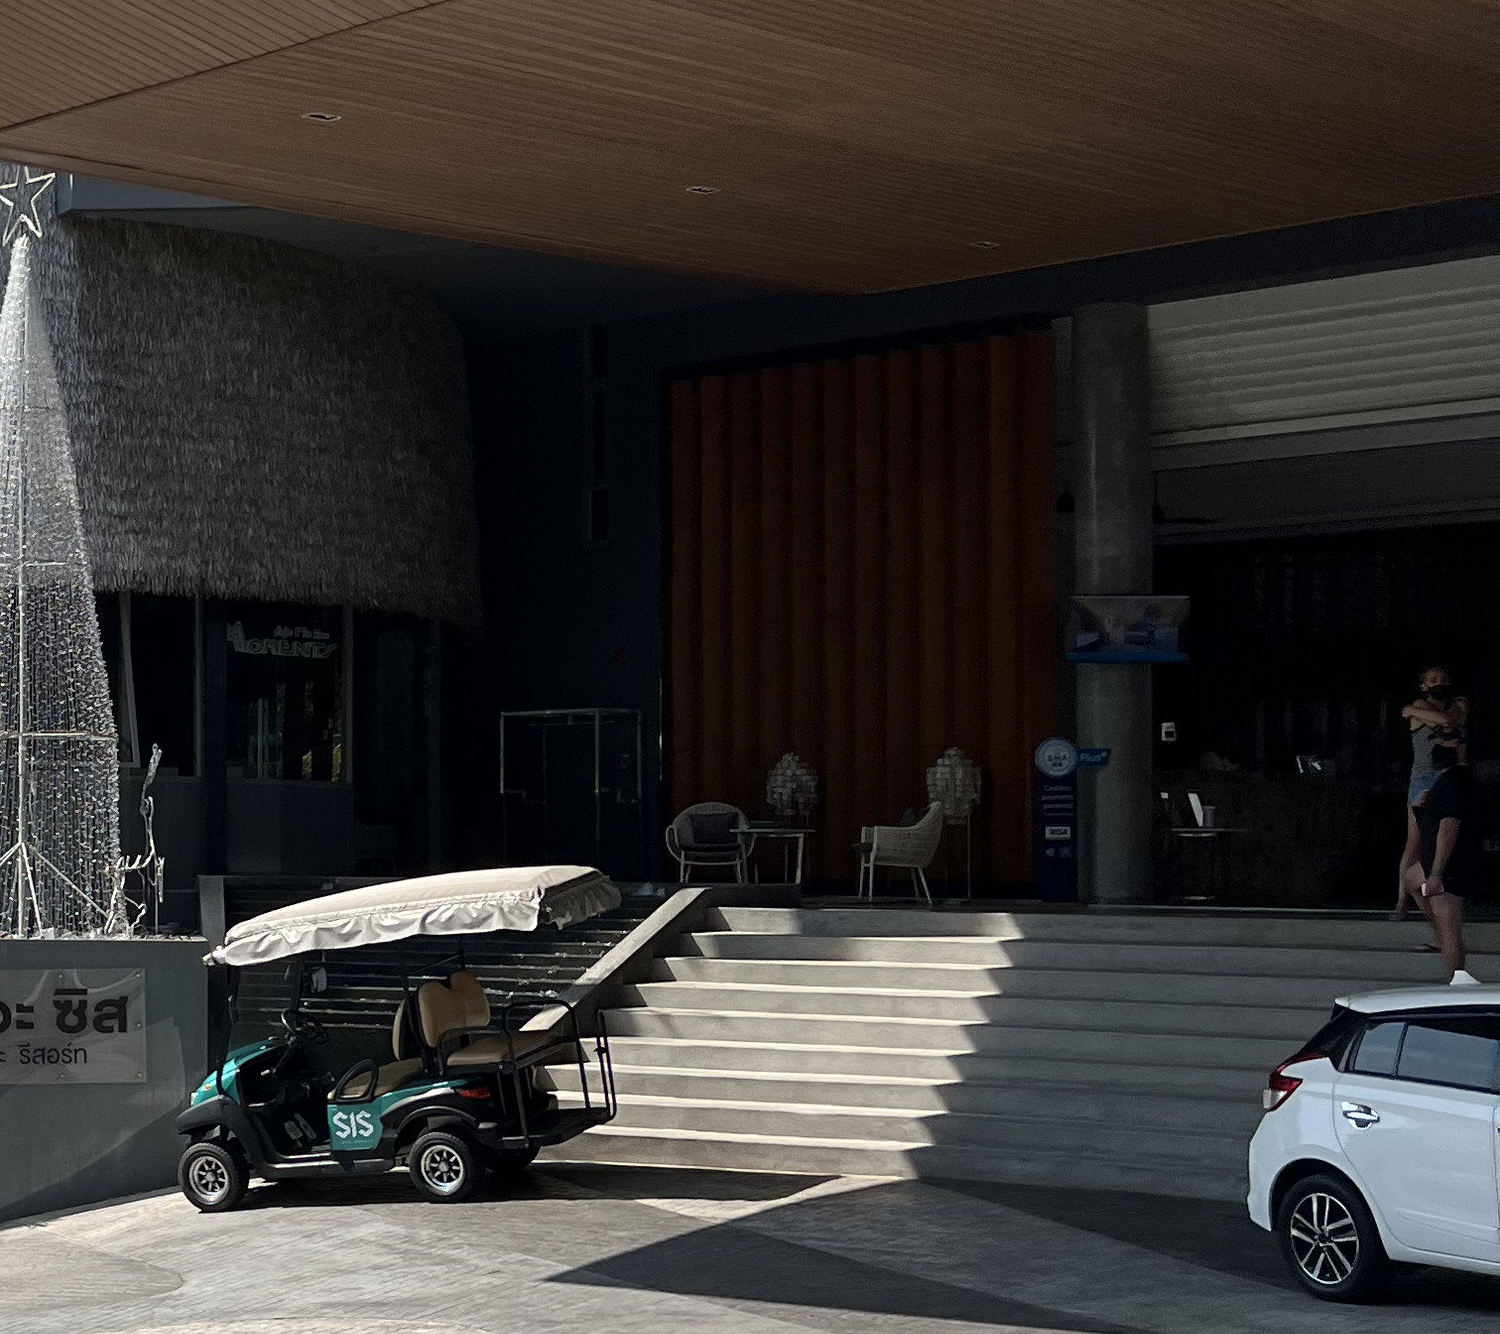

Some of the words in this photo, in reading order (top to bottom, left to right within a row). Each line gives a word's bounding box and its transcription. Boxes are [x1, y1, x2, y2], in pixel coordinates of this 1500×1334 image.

[53, 988, 129, 1034] ซิส
[18, 1042, 87, 1065] รีสอร์ท
[332, 1110, 374, 1139] SIS
